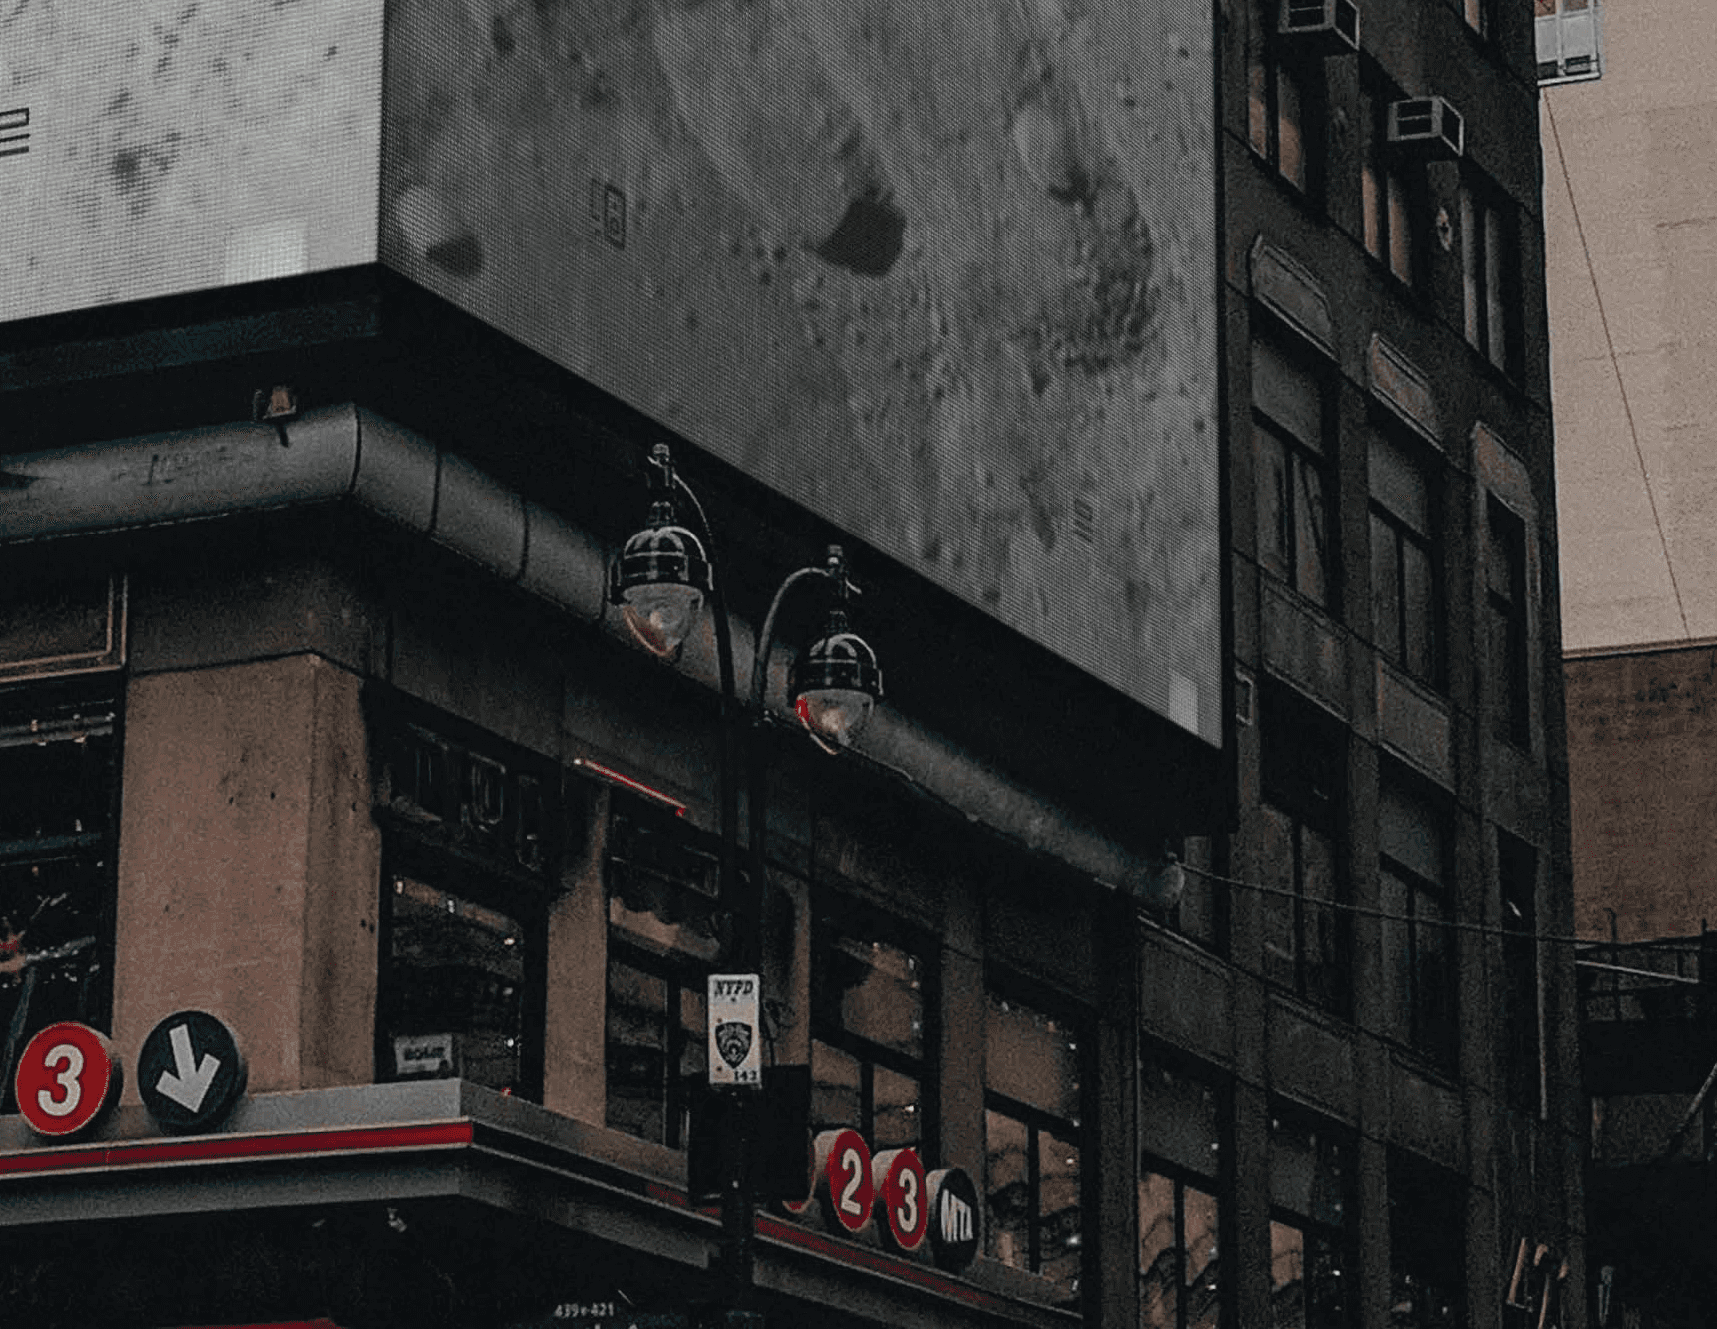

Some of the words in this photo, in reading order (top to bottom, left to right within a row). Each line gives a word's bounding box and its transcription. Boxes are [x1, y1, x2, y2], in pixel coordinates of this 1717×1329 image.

[714, 980, 754, 995] NYPD
[36, 1041, 85, 1118] 3
[840, 1147, 863, 1216] 2
[896, 1167, 918, 1234] 3
[940, 1188, 974, 1243] MTA
